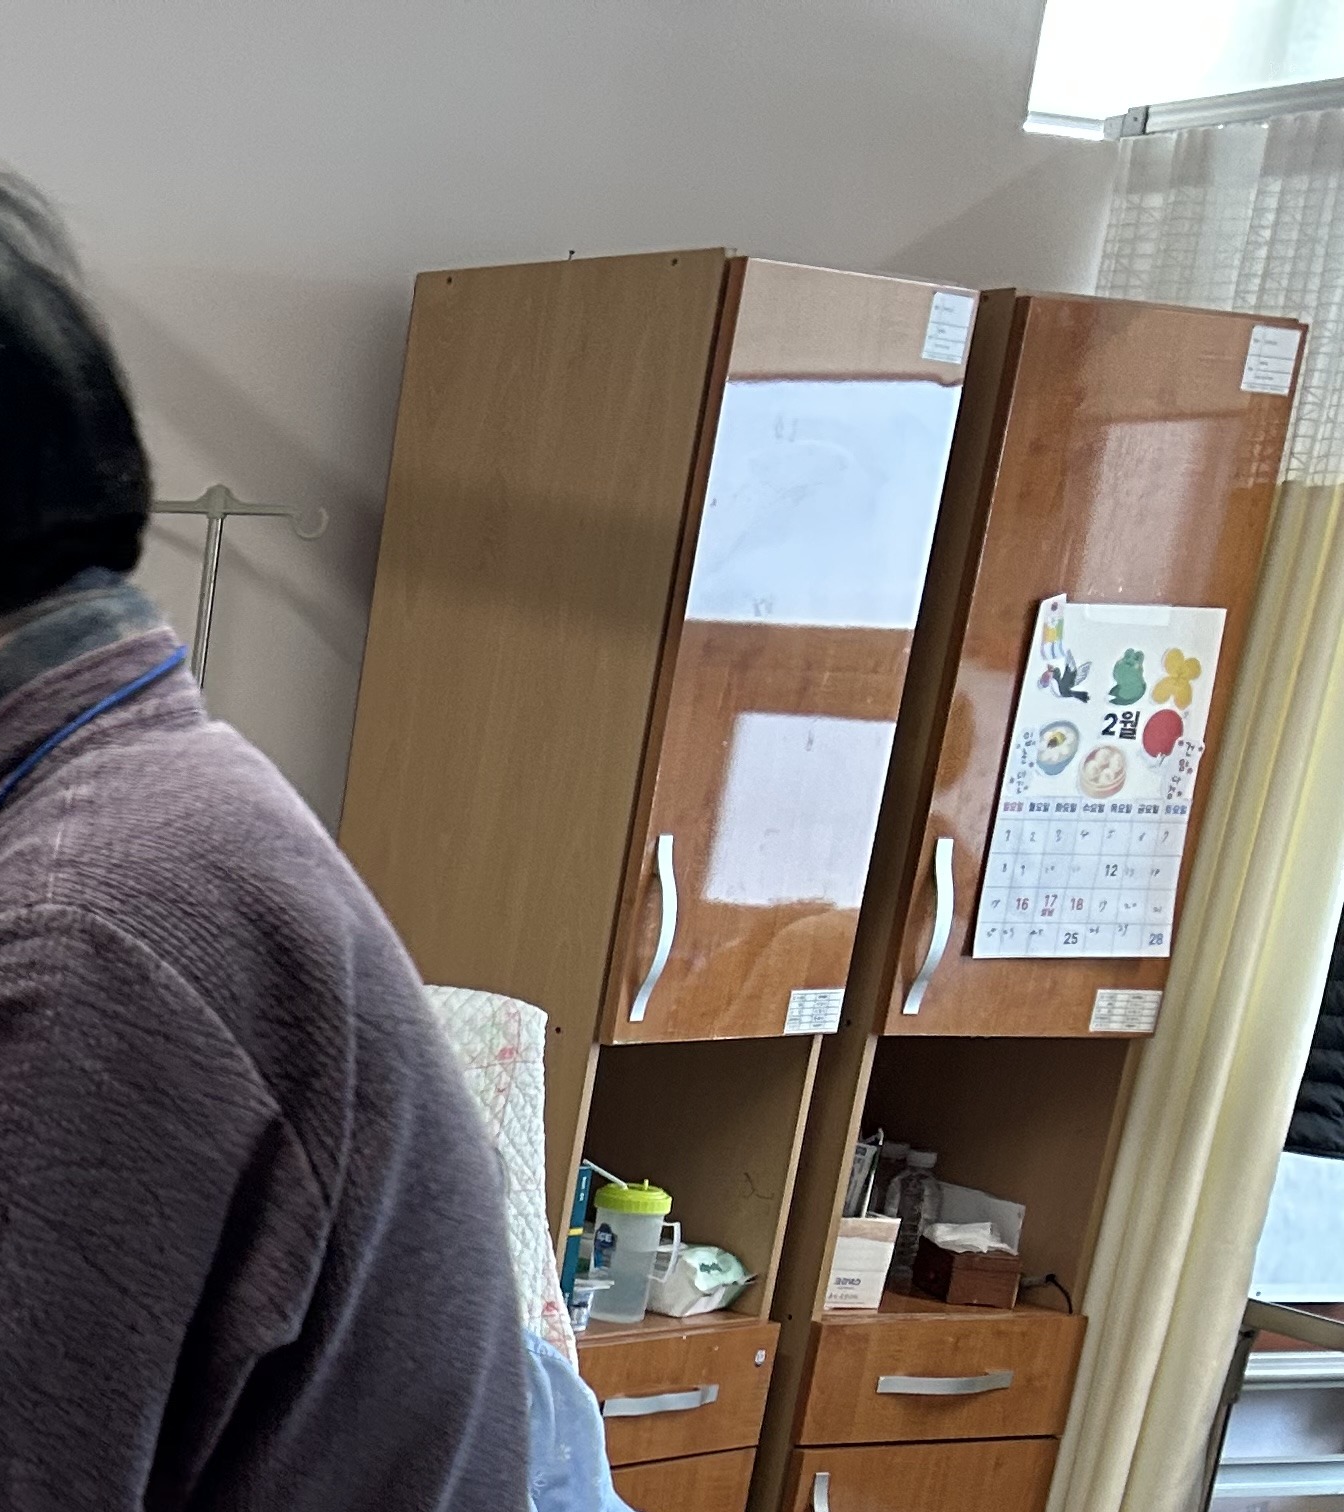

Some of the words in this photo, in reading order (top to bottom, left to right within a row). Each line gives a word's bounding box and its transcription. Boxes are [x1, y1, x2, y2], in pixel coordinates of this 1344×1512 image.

[1101, 711, 1140, 740] 2월
[1105, 864, 1118, 877] 12
[1015, 897, 1029, 910] 16
[1044, 894, 1058, 907] 17
[1070, 897, 1084, 911] 18
[1063, 932, 1079, 945] 25
[1149, 933, 1164, 945] 28
